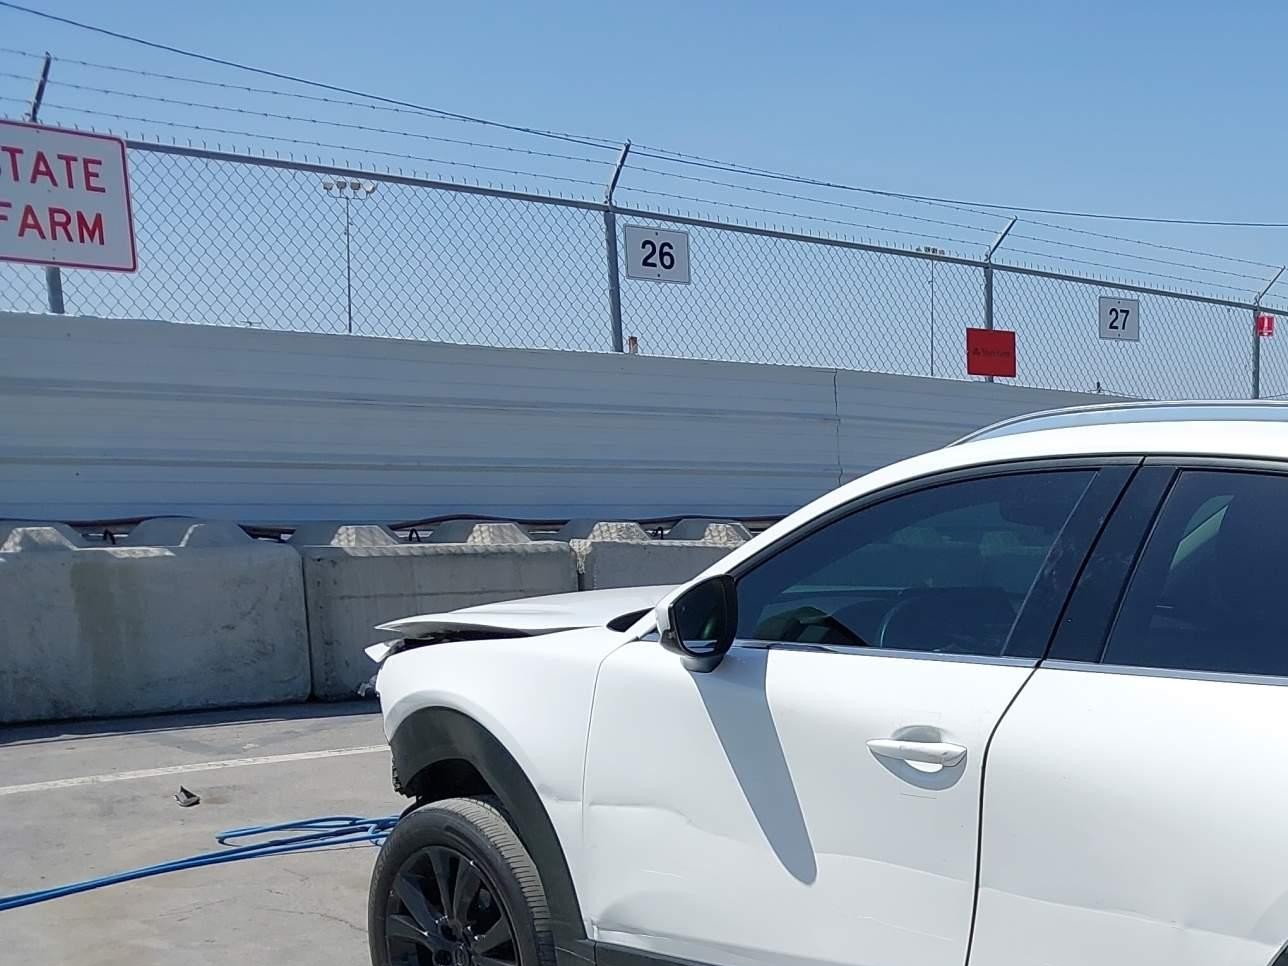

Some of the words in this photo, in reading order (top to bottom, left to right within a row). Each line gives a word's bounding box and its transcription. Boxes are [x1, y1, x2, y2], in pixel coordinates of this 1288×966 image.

[0, 146, 106, 193] TATE
[641, 240, 675, 270] 26
[1109, 308, 1130, 330] 27
